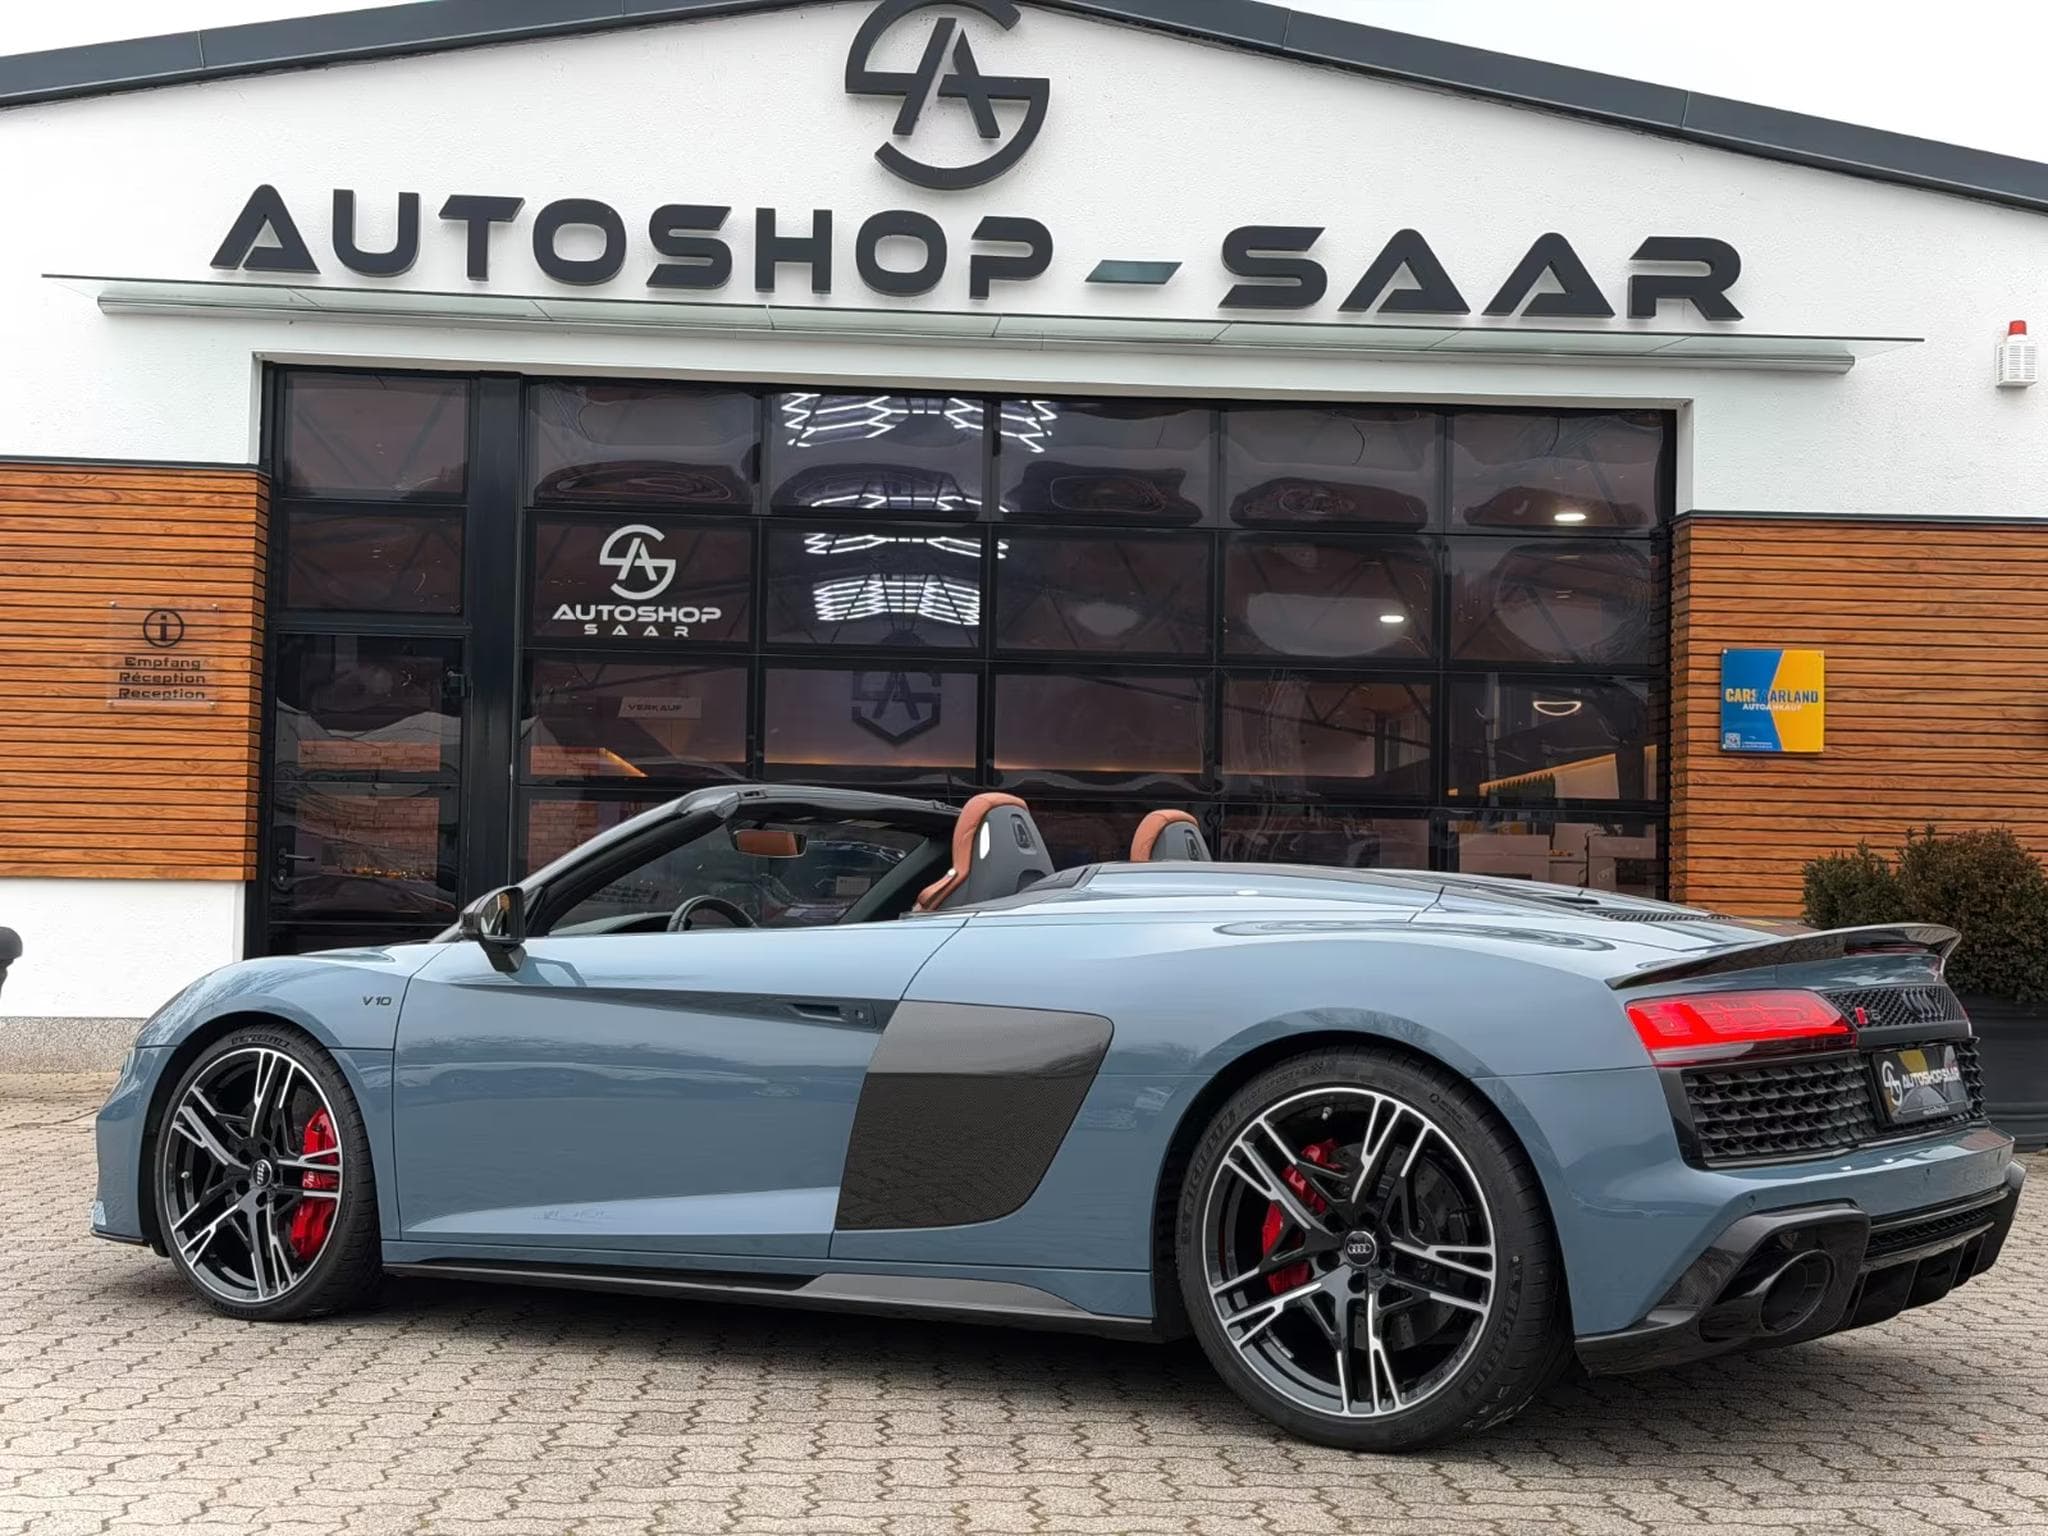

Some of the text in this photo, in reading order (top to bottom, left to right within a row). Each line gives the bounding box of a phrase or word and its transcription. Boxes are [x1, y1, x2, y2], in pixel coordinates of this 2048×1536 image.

[211, 184, 1053, 299] AUTOSHOP
[1219, 225, 1744, 321] SAAR
[552, 603, 722, 623] AUTOSHOP
[584, 623, 689, 637] SAAR
[124, 657, 201, 671] Empfang
[119, 671, 206, 685] Réception
[119, 687, 206, 700] Reception
[362, 996, 392, 1006] V10
